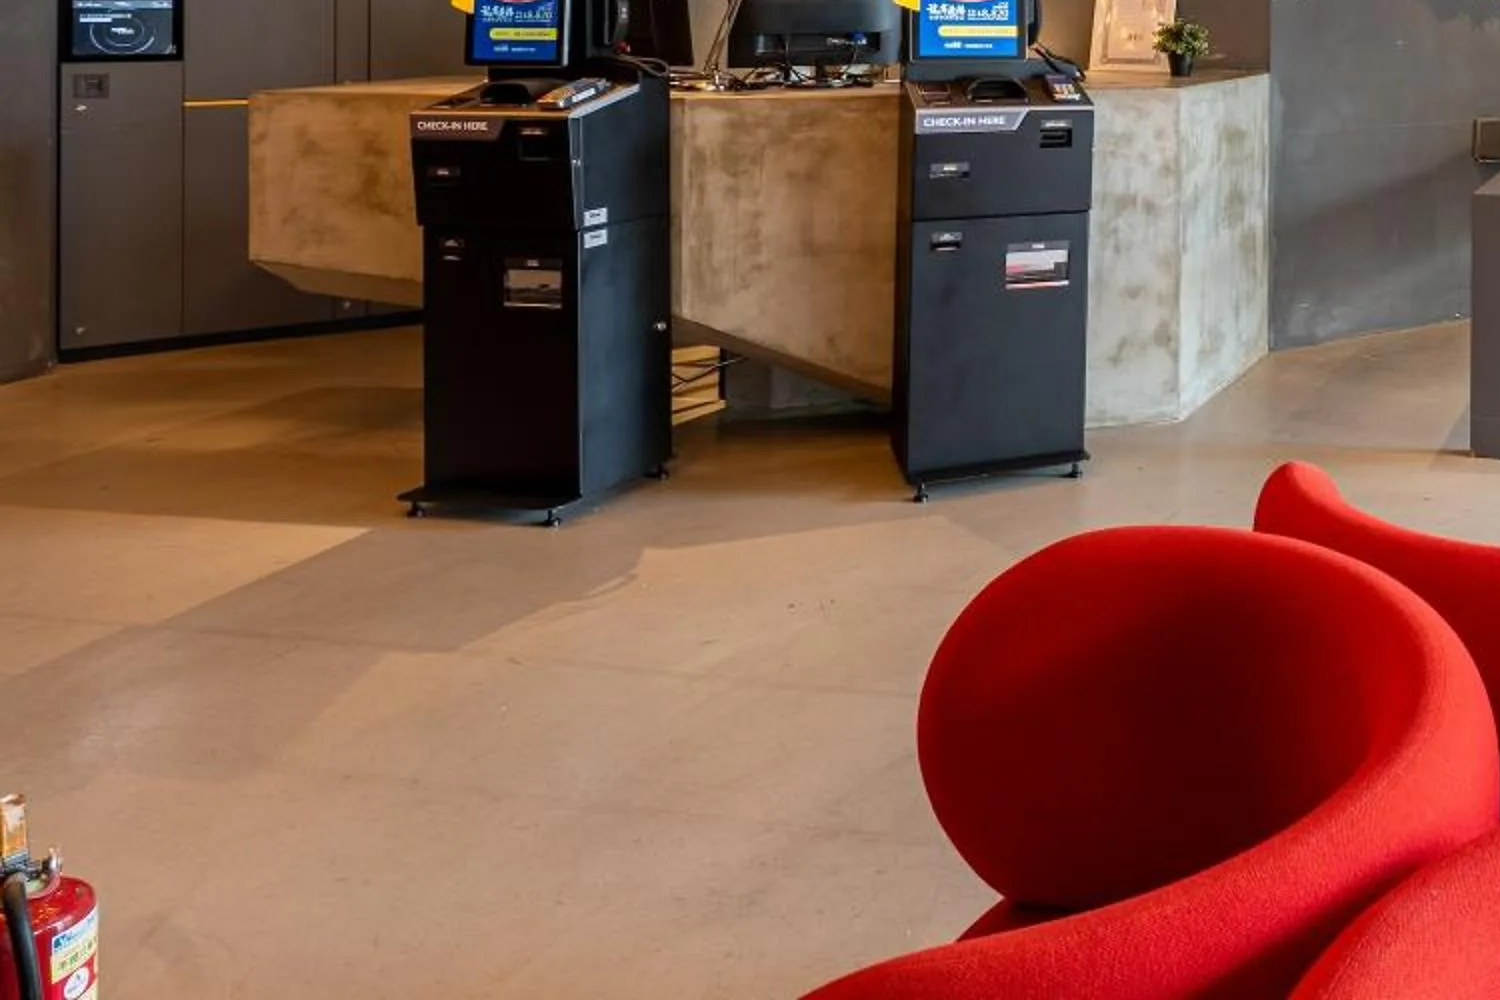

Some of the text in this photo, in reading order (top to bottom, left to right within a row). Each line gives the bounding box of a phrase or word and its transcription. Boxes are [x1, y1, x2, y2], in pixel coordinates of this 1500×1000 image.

[418, 120, 489, 131] CHECK-IN HERE
[923, 115, 1005, 127] CHECK-IN HERE
